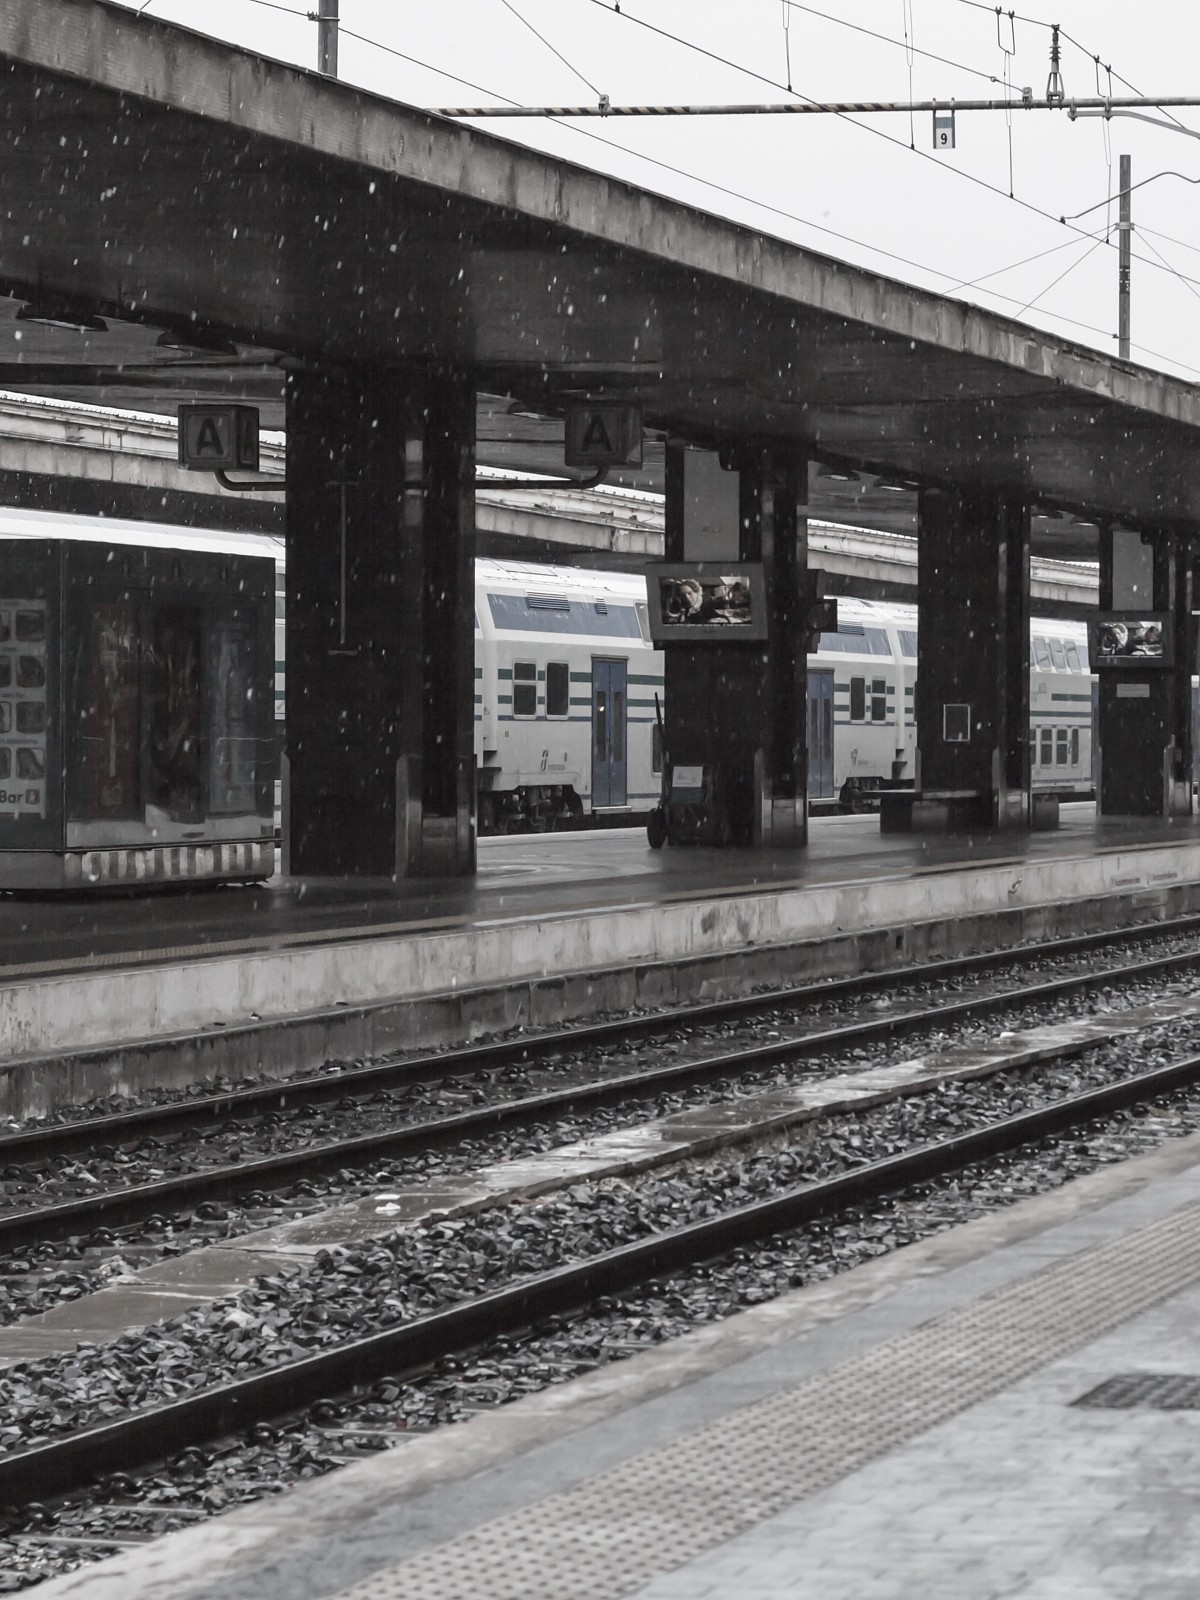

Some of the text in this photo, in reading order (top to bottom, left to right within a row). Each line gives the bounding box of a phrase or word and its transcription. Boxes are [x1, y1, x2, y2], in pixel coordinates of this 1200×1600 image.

[940, 132, 948, 145] 9
[196, 418, 224, 456] A
[580, 414, 613, 452] A
[0, 789, 23, 804] Bar
